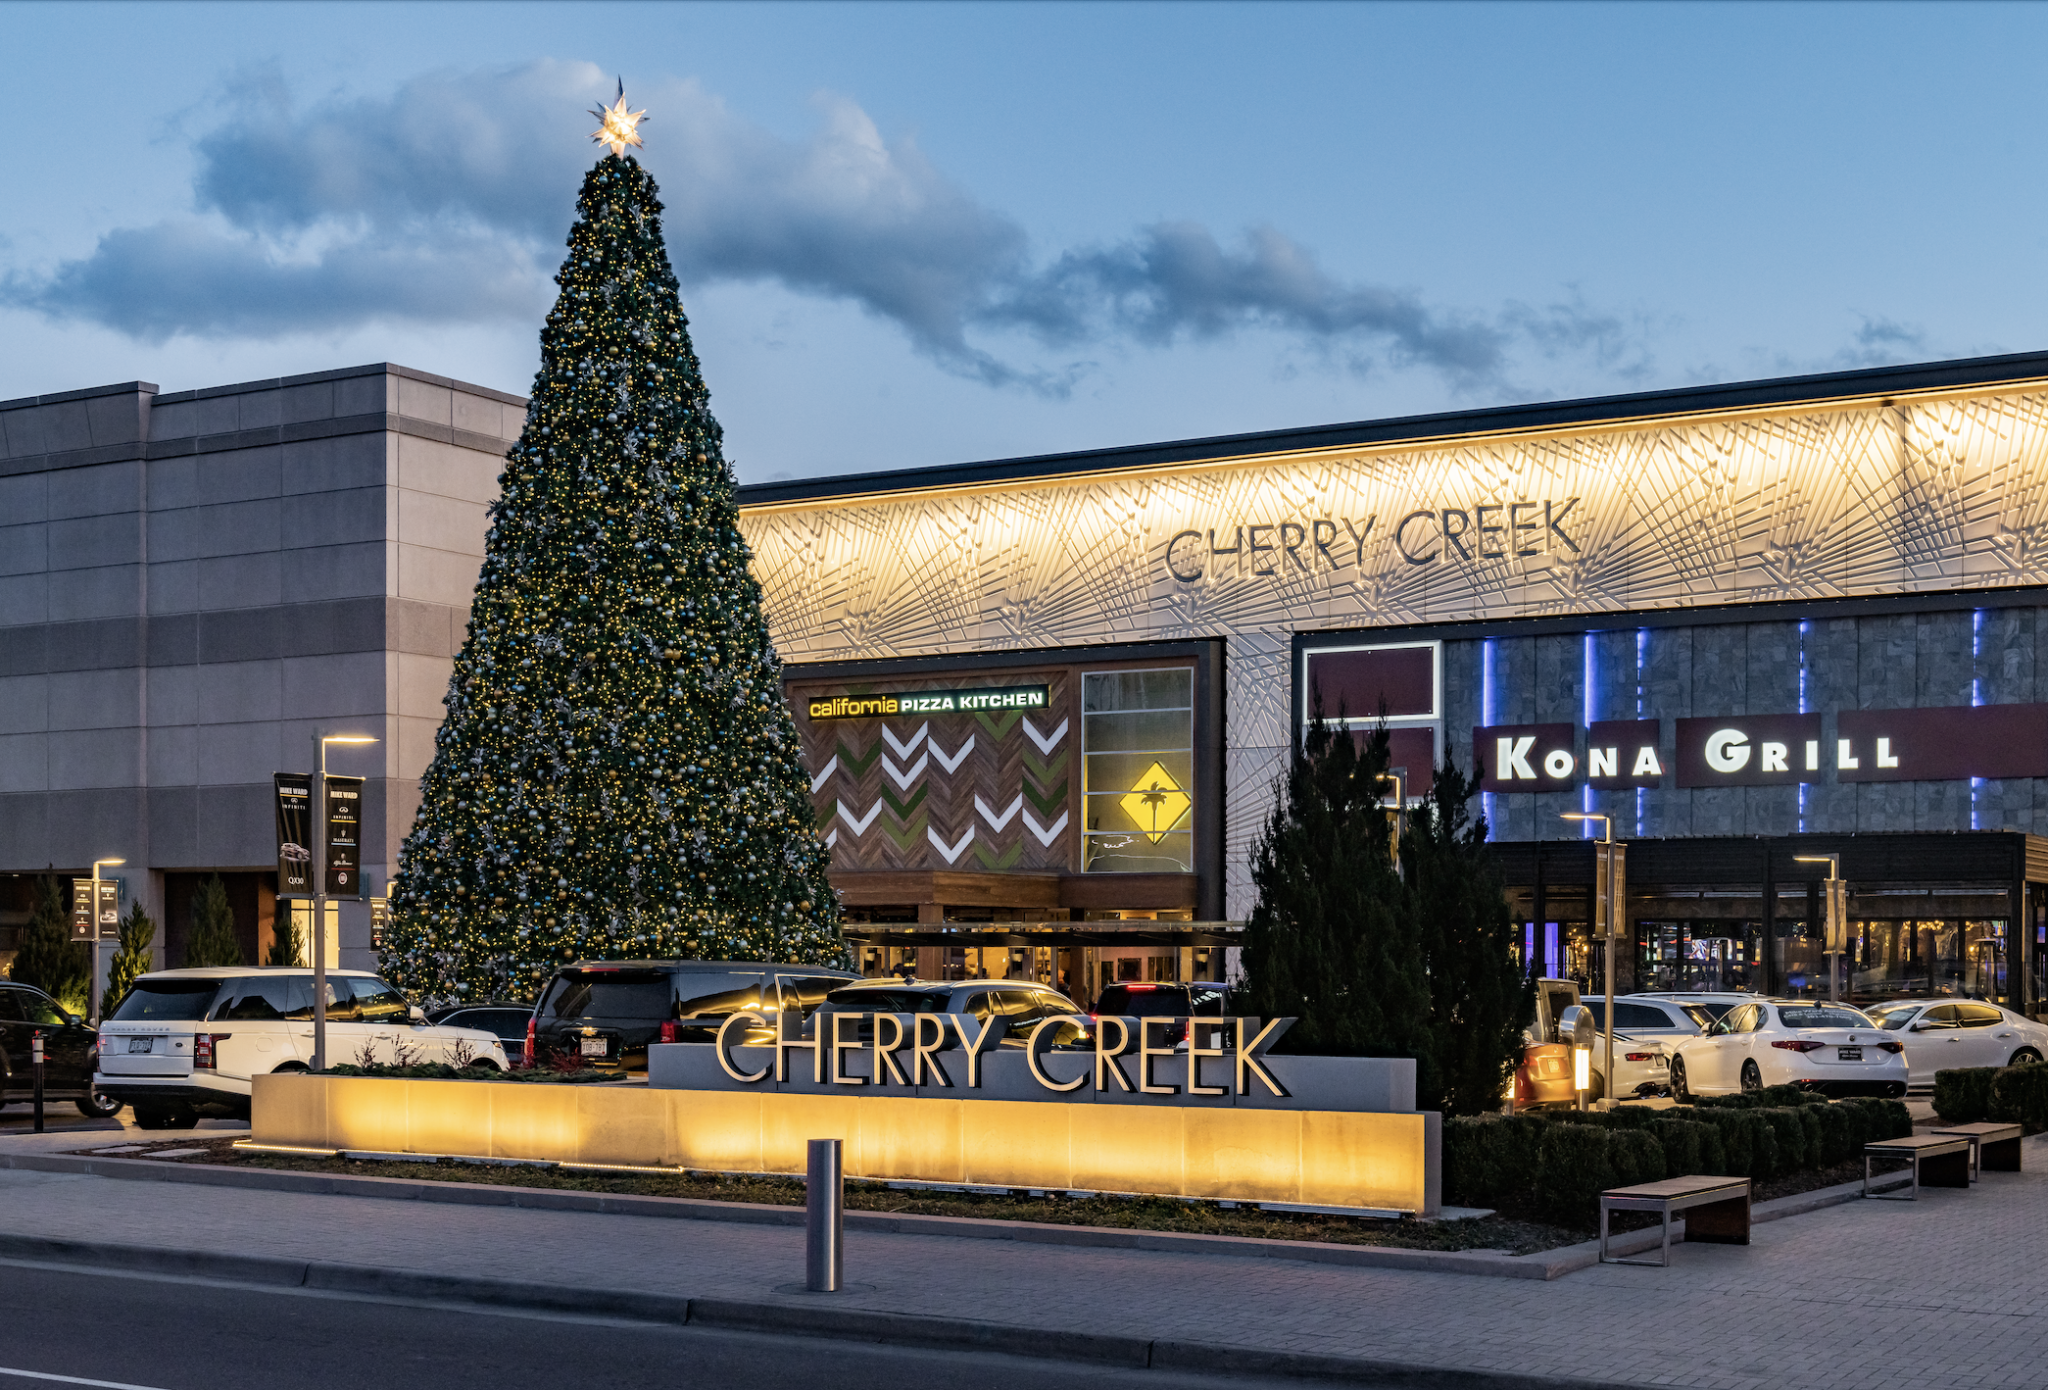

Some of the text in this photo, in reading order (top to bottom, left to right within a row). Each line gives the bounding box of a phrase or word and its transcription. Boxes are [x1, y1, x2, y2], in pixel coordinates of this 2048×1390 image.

[1165, 497, 1581, 583] CHERRY CREEK
[809, 692, 1043, 718] california PIZZA KITCHEN
[1496, 728, 1898, 780] KONA GRILL
[716, 1013, 1293, 1097] CHERRY CREEK
